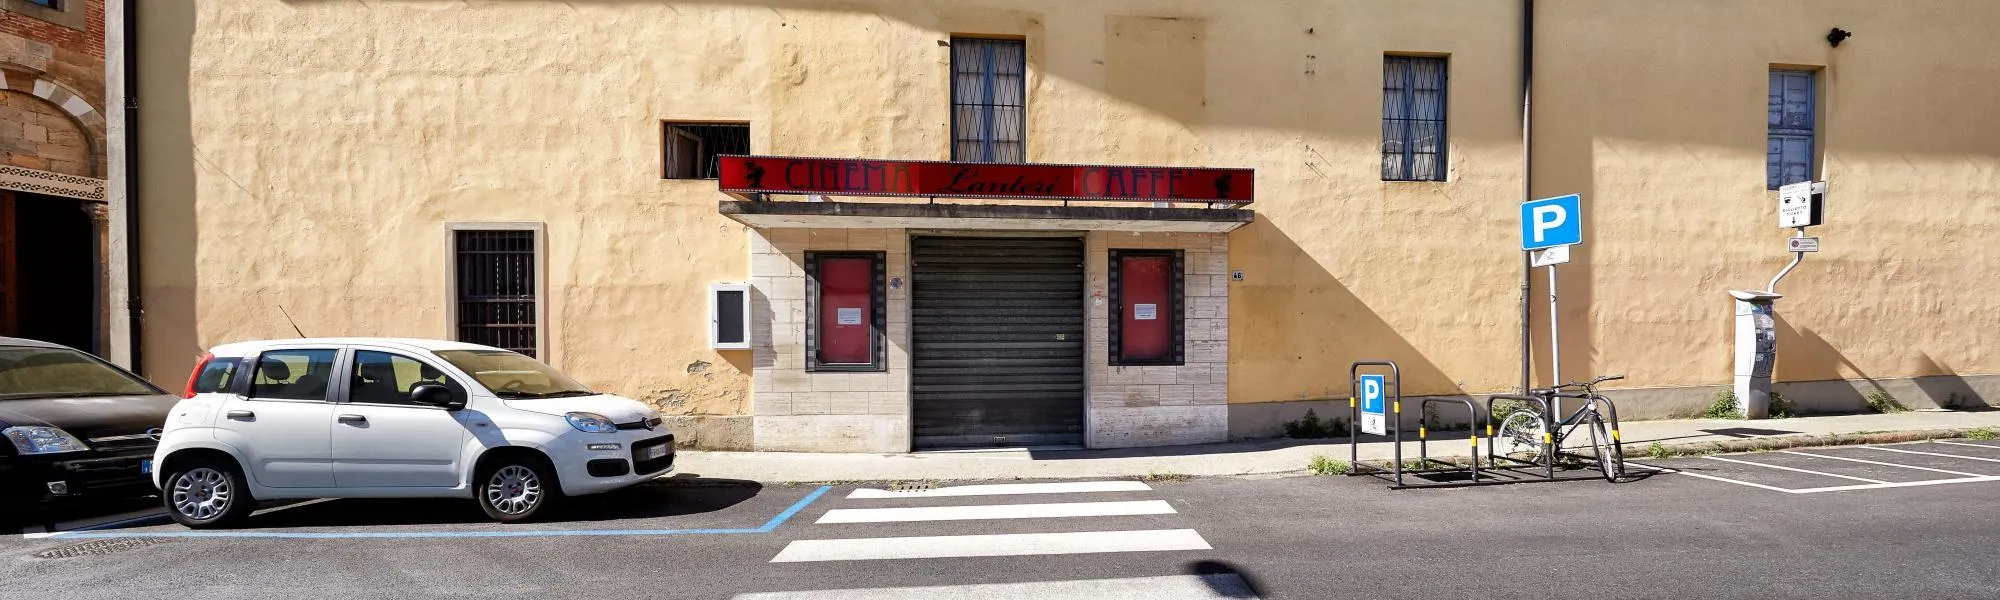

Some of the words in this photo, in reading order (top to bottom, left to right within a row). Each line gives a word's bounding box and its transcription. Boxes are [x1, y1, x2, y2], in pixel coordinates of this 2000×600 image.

[785, 160, 913, 192] CINEMA
[939, 166, 1061, 193] Lanteri
[1533, 204, 1567, 243] P
[1365, 379, 1379, 409] P
